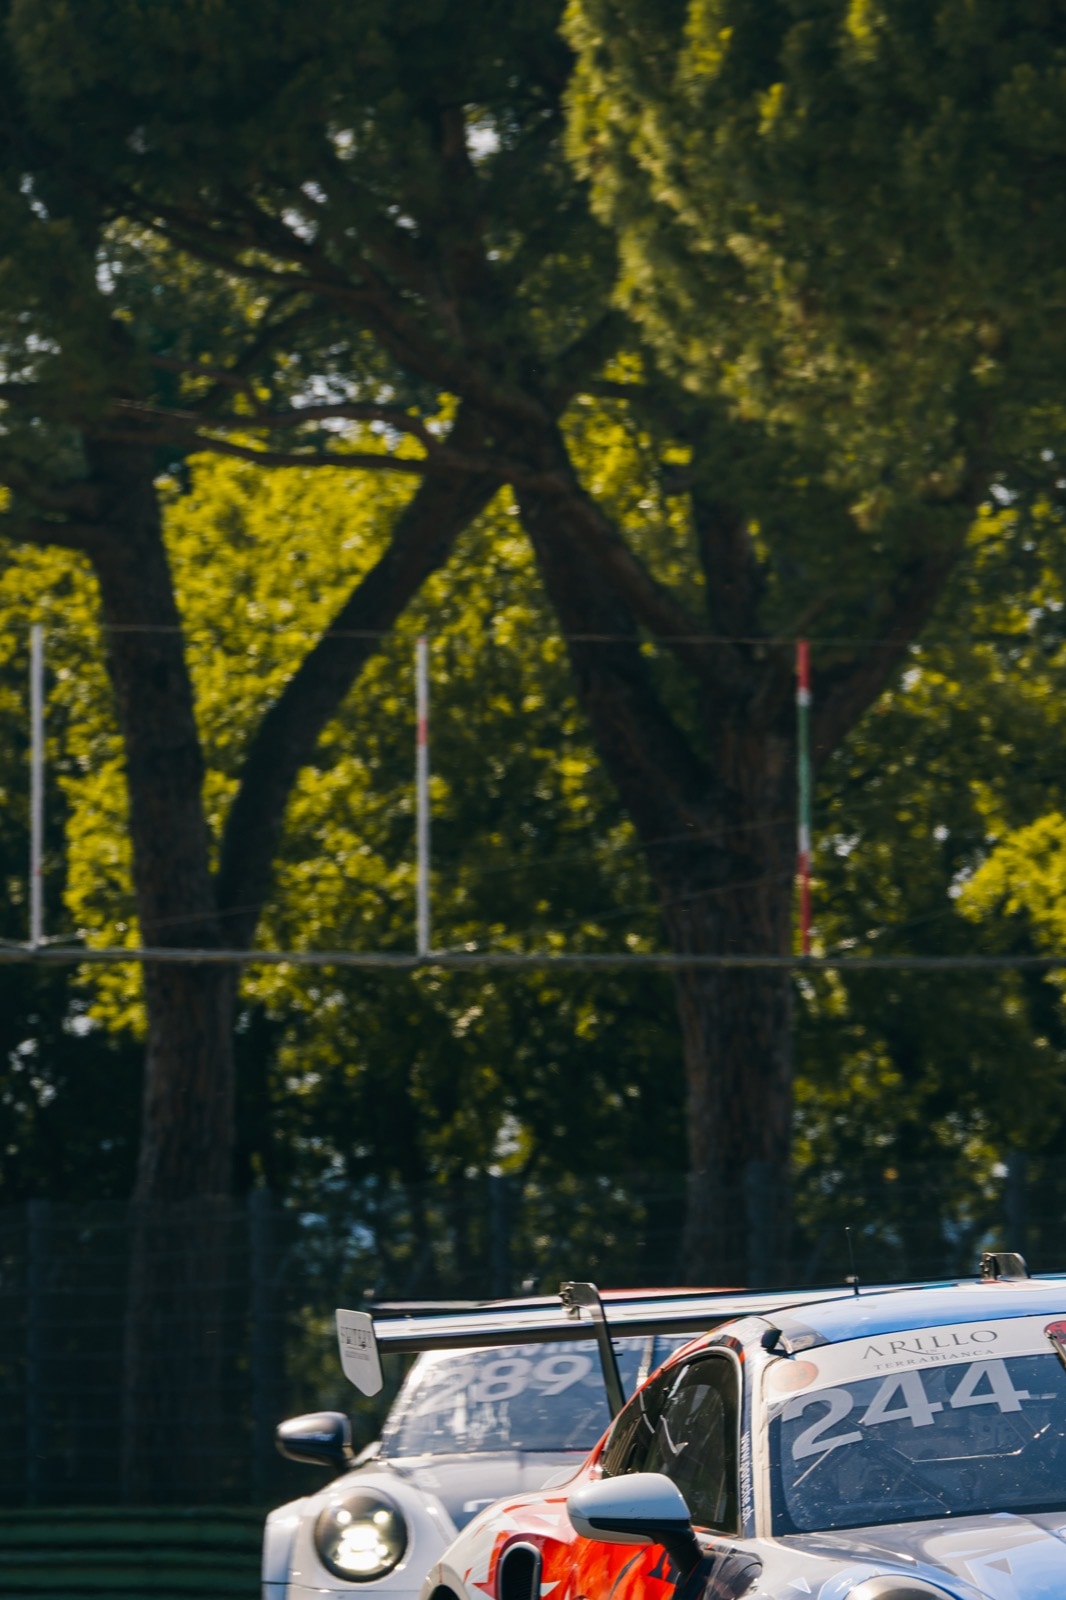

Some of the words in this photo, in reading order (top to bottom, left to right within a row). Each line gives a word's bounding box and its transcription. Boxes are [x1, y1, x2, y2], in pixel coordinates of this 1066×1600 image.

[862, 1330, 998, 1360] ARILLO
[874, 1349, 995, 1370] TERRABIANCA
[412, 1355, 593, 1418] 289
[781, 1359, 1031, 1461] 244
